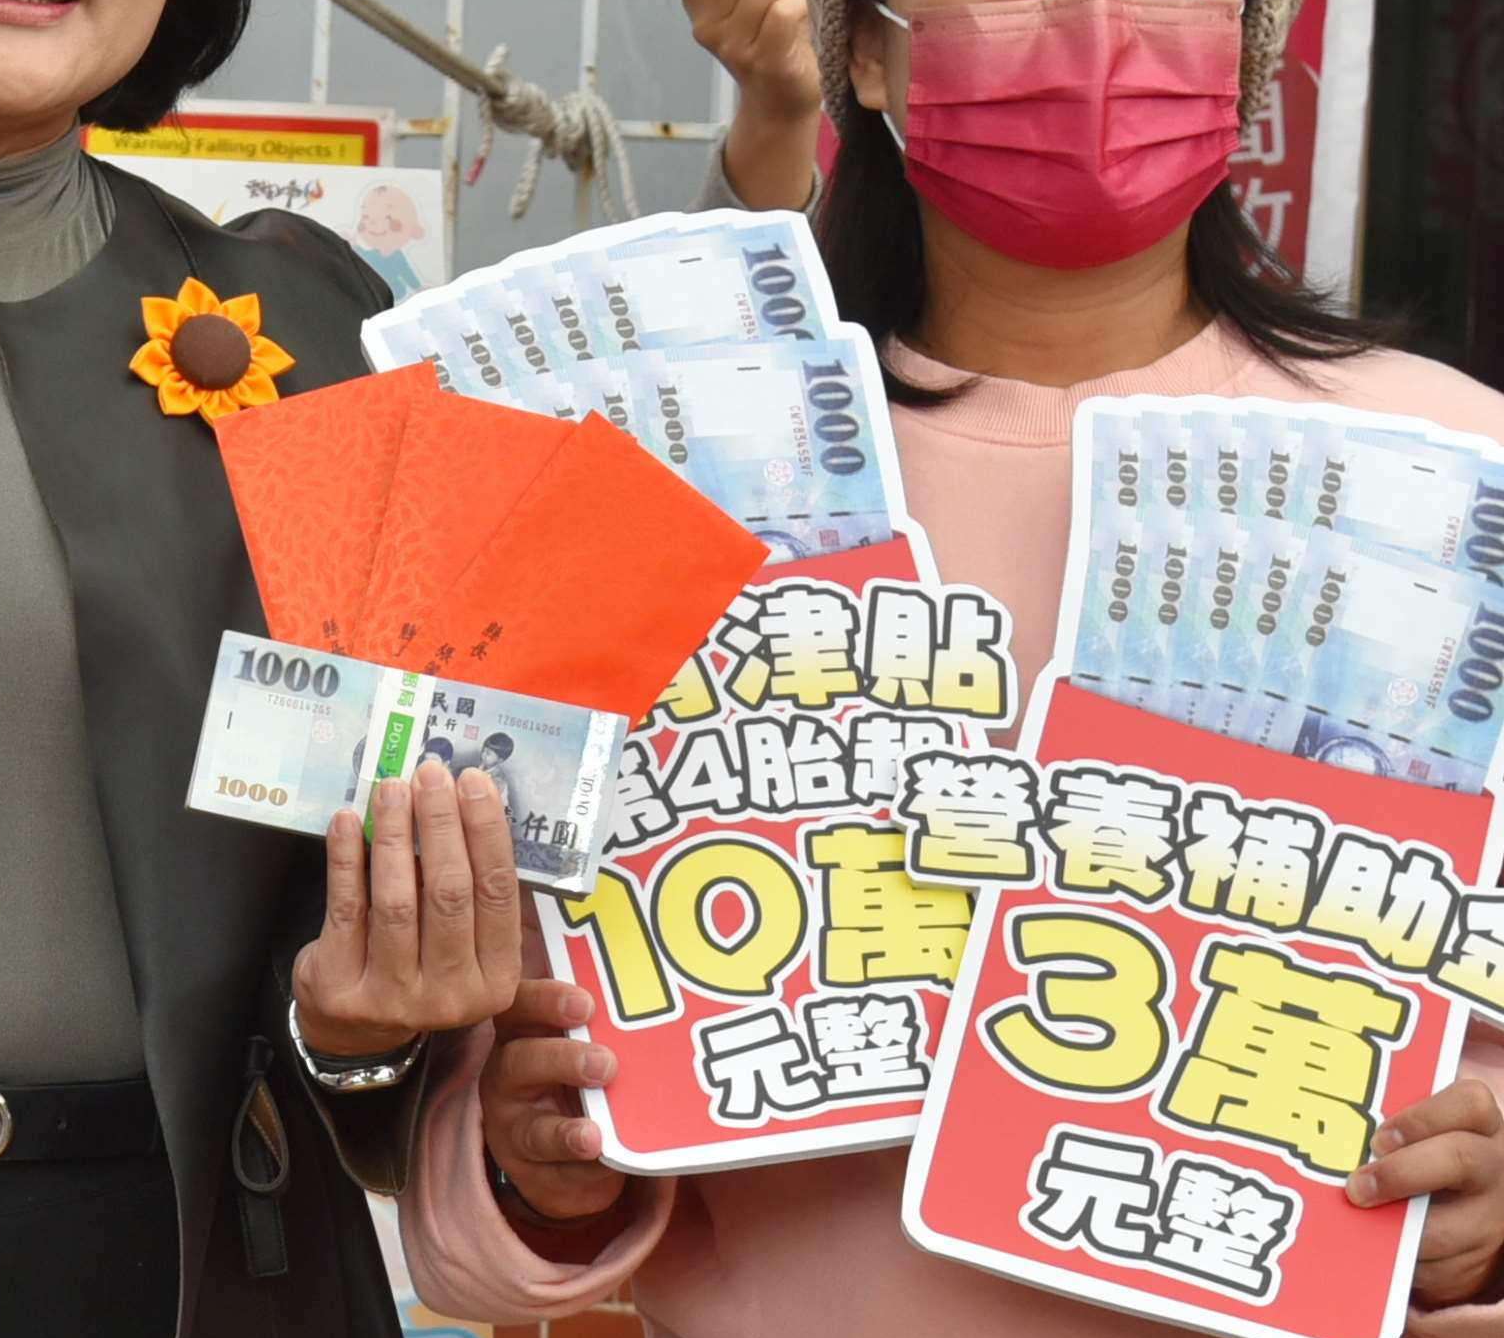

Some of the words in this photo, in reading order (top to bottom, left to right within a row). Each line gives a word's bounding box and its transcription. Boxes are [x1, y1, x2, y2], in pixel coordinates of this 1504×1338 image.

[112, 133, 191, 154] Warning
[193, 136, 257, 158] Falling
[261, 139, 332, 161] Objects
[656, 383, 689, 465] 1000
[801, 358, 867, 477] 1000
[1107, 539, 1139, 624] 1000
[1157, 541, 1188, 627] 1000
[1209, 546, 1240, 631] 1000
[1255, 552, 1292, 637] 1000
[1304, 565, 1348, 648] 1000
[232, 645, 342, 700] 1000
[214, 773, 290, 808] 1000
[701, 994, 931, 1120] 元整
[984, 910, 1413, 1178] 3萬
[1027, 1130, 1293, 1298] 元整
